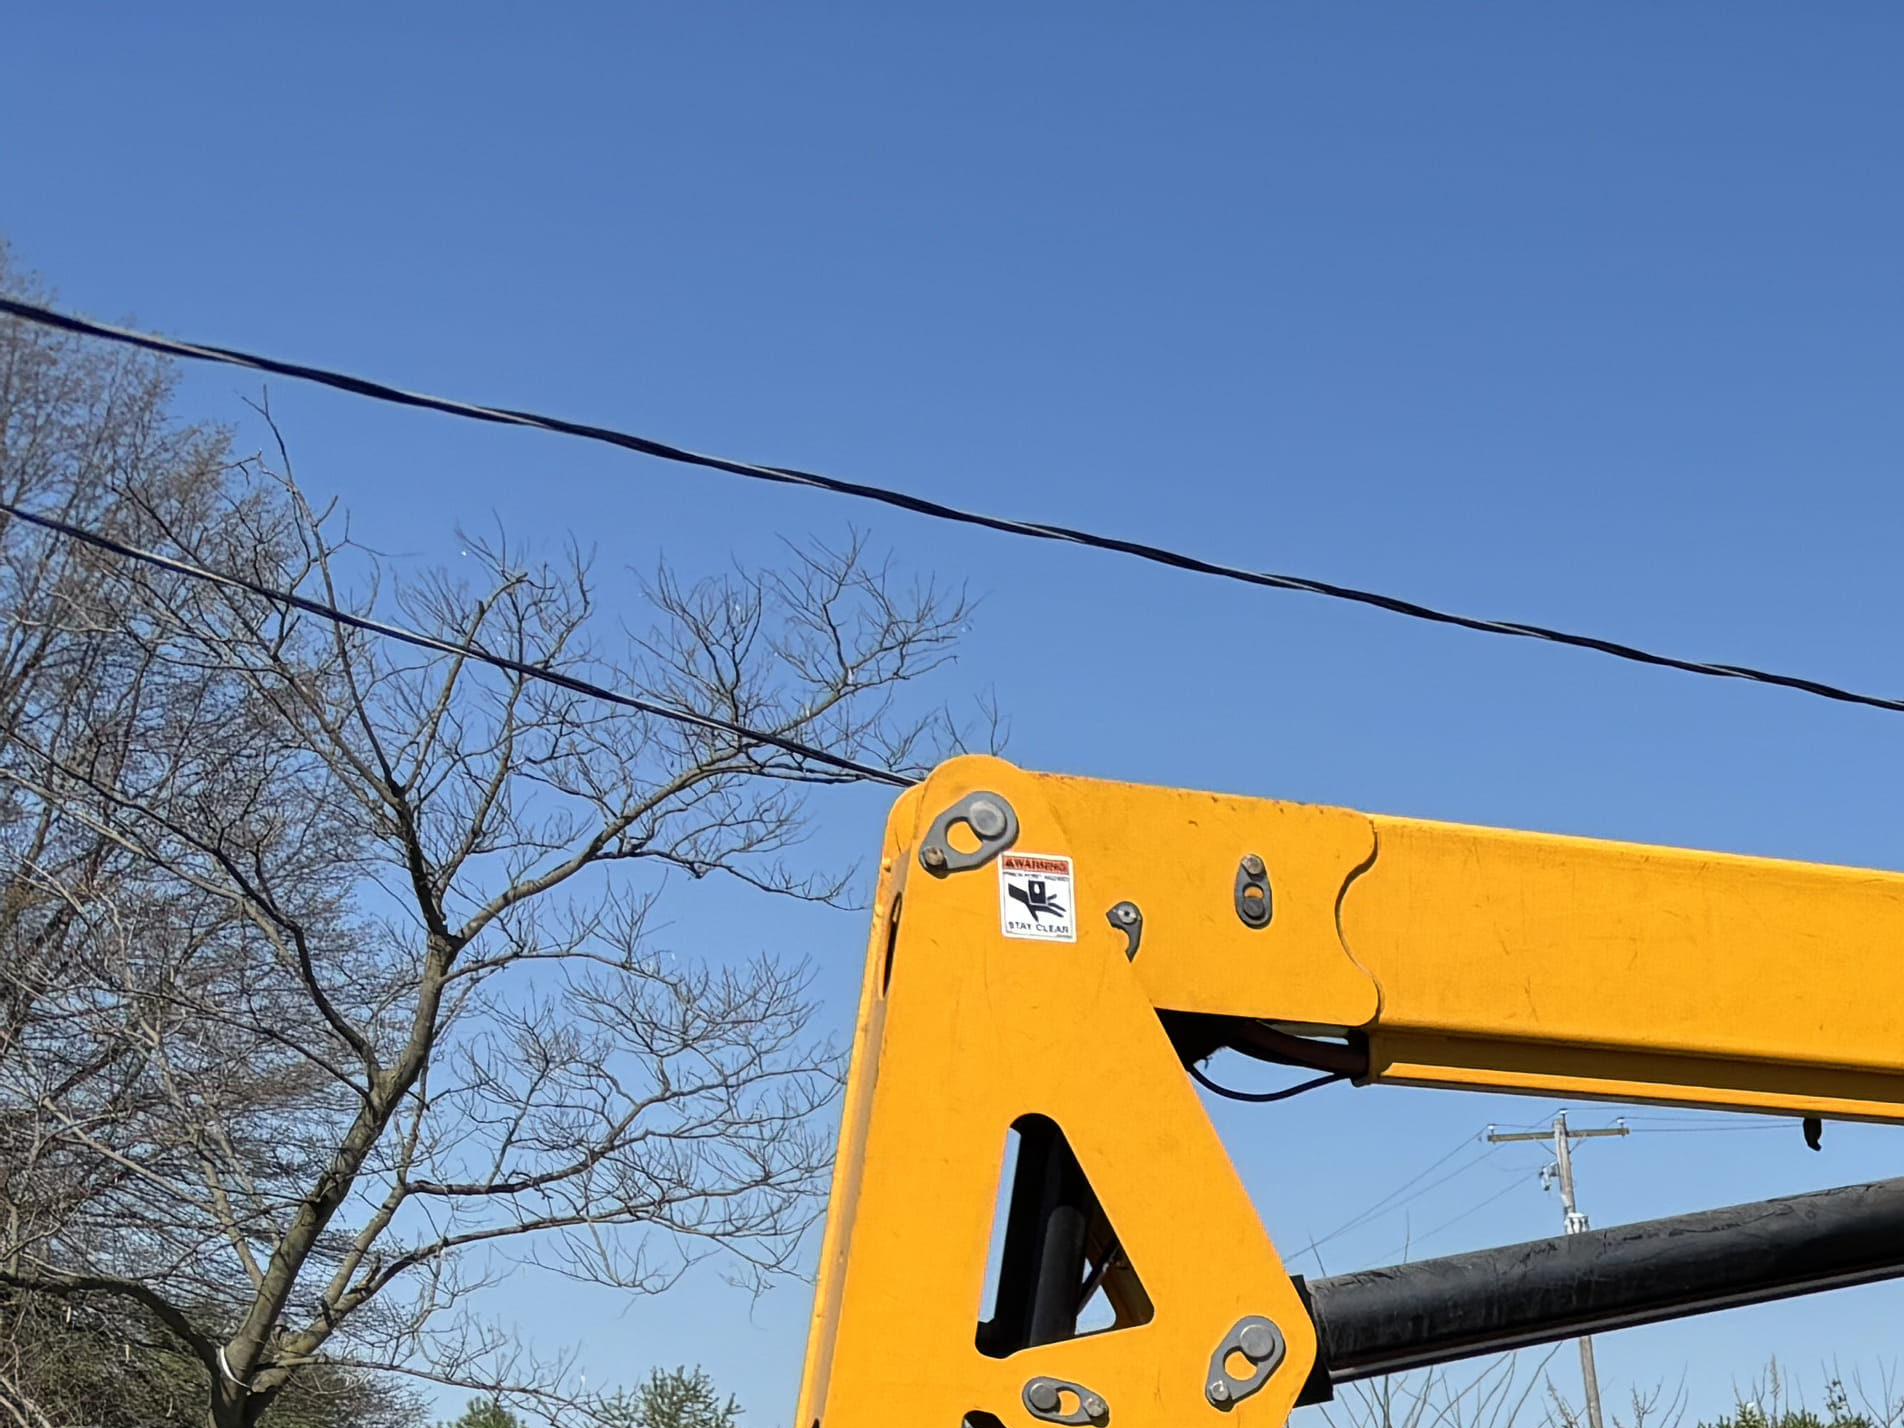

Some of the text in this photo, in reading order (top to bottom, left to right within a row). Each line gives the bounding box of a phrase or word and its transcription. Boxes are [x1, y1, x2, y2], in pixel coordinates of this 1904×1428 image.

[1013, 859, 1067, 873] WARNING
[1008, 921, 1069, 933] STAY CLEAR
